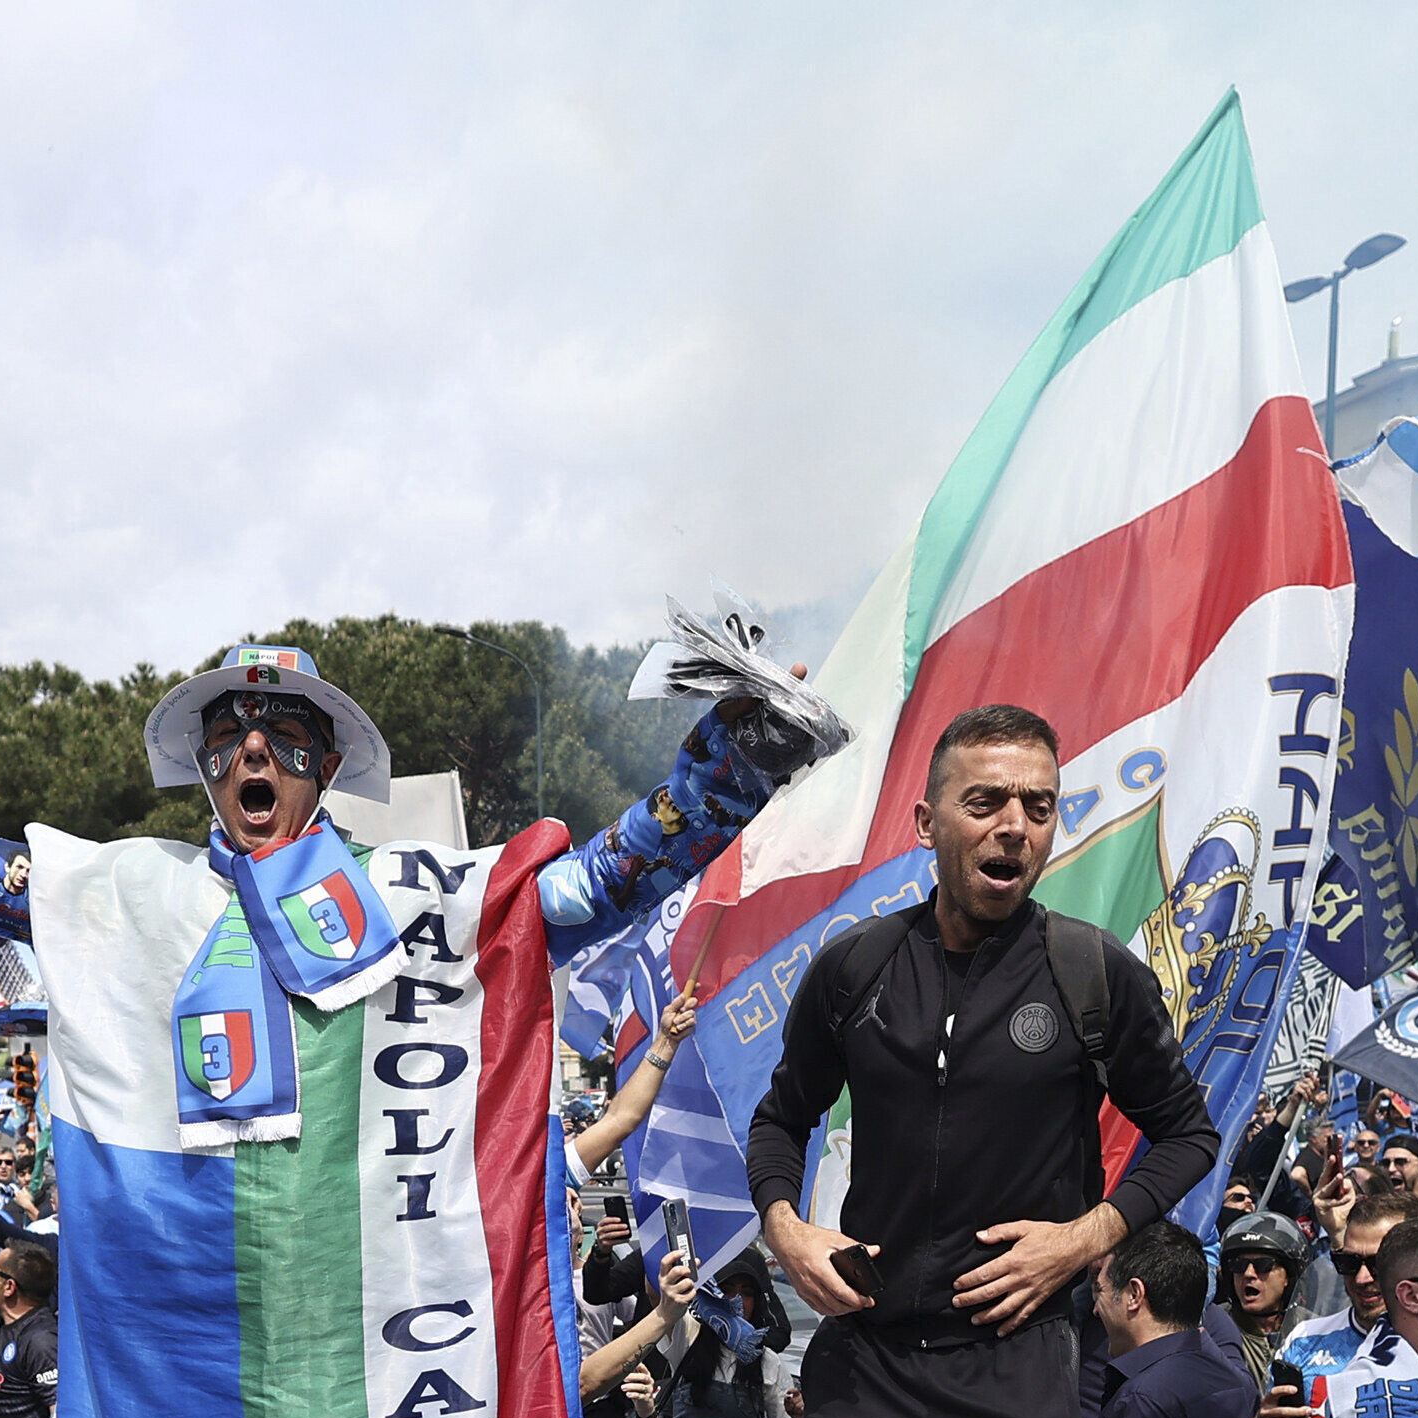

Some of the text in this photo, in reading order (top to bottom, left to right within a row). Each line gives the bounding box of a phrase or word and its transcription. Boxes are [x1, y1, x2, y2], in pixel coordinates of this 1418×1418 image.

[309, 897, 350, 944] 3
[373, 850, 476, 1222] NAPOLI
[1021, 1009, 1049, 1020] PARIS
[199, 1033, 233, 1081] 3
